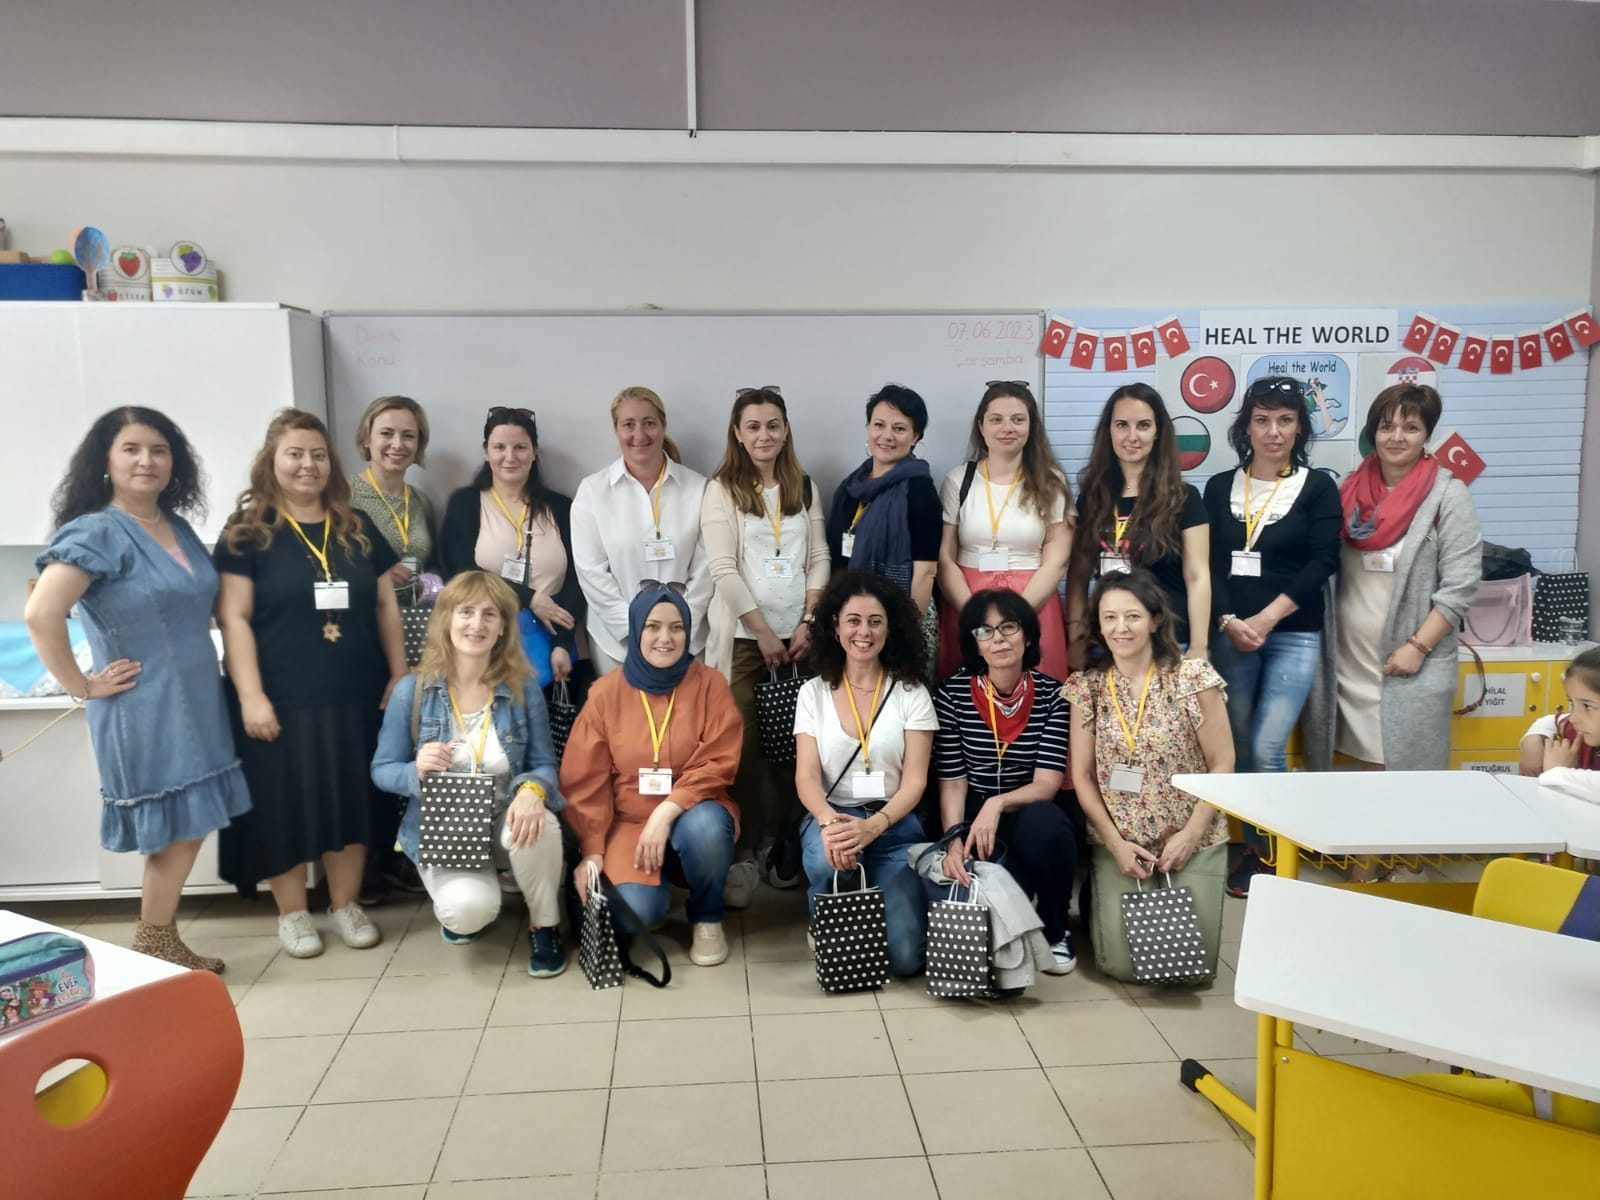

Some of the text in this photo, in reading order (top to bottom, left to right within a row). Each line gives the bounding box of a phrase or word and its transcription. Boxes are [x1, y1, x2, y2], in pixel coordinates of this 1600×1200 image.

[1205, 326, 1390, 345] HEAL THE WORLD
[1268, 359, 1337, 373] Heal the World
